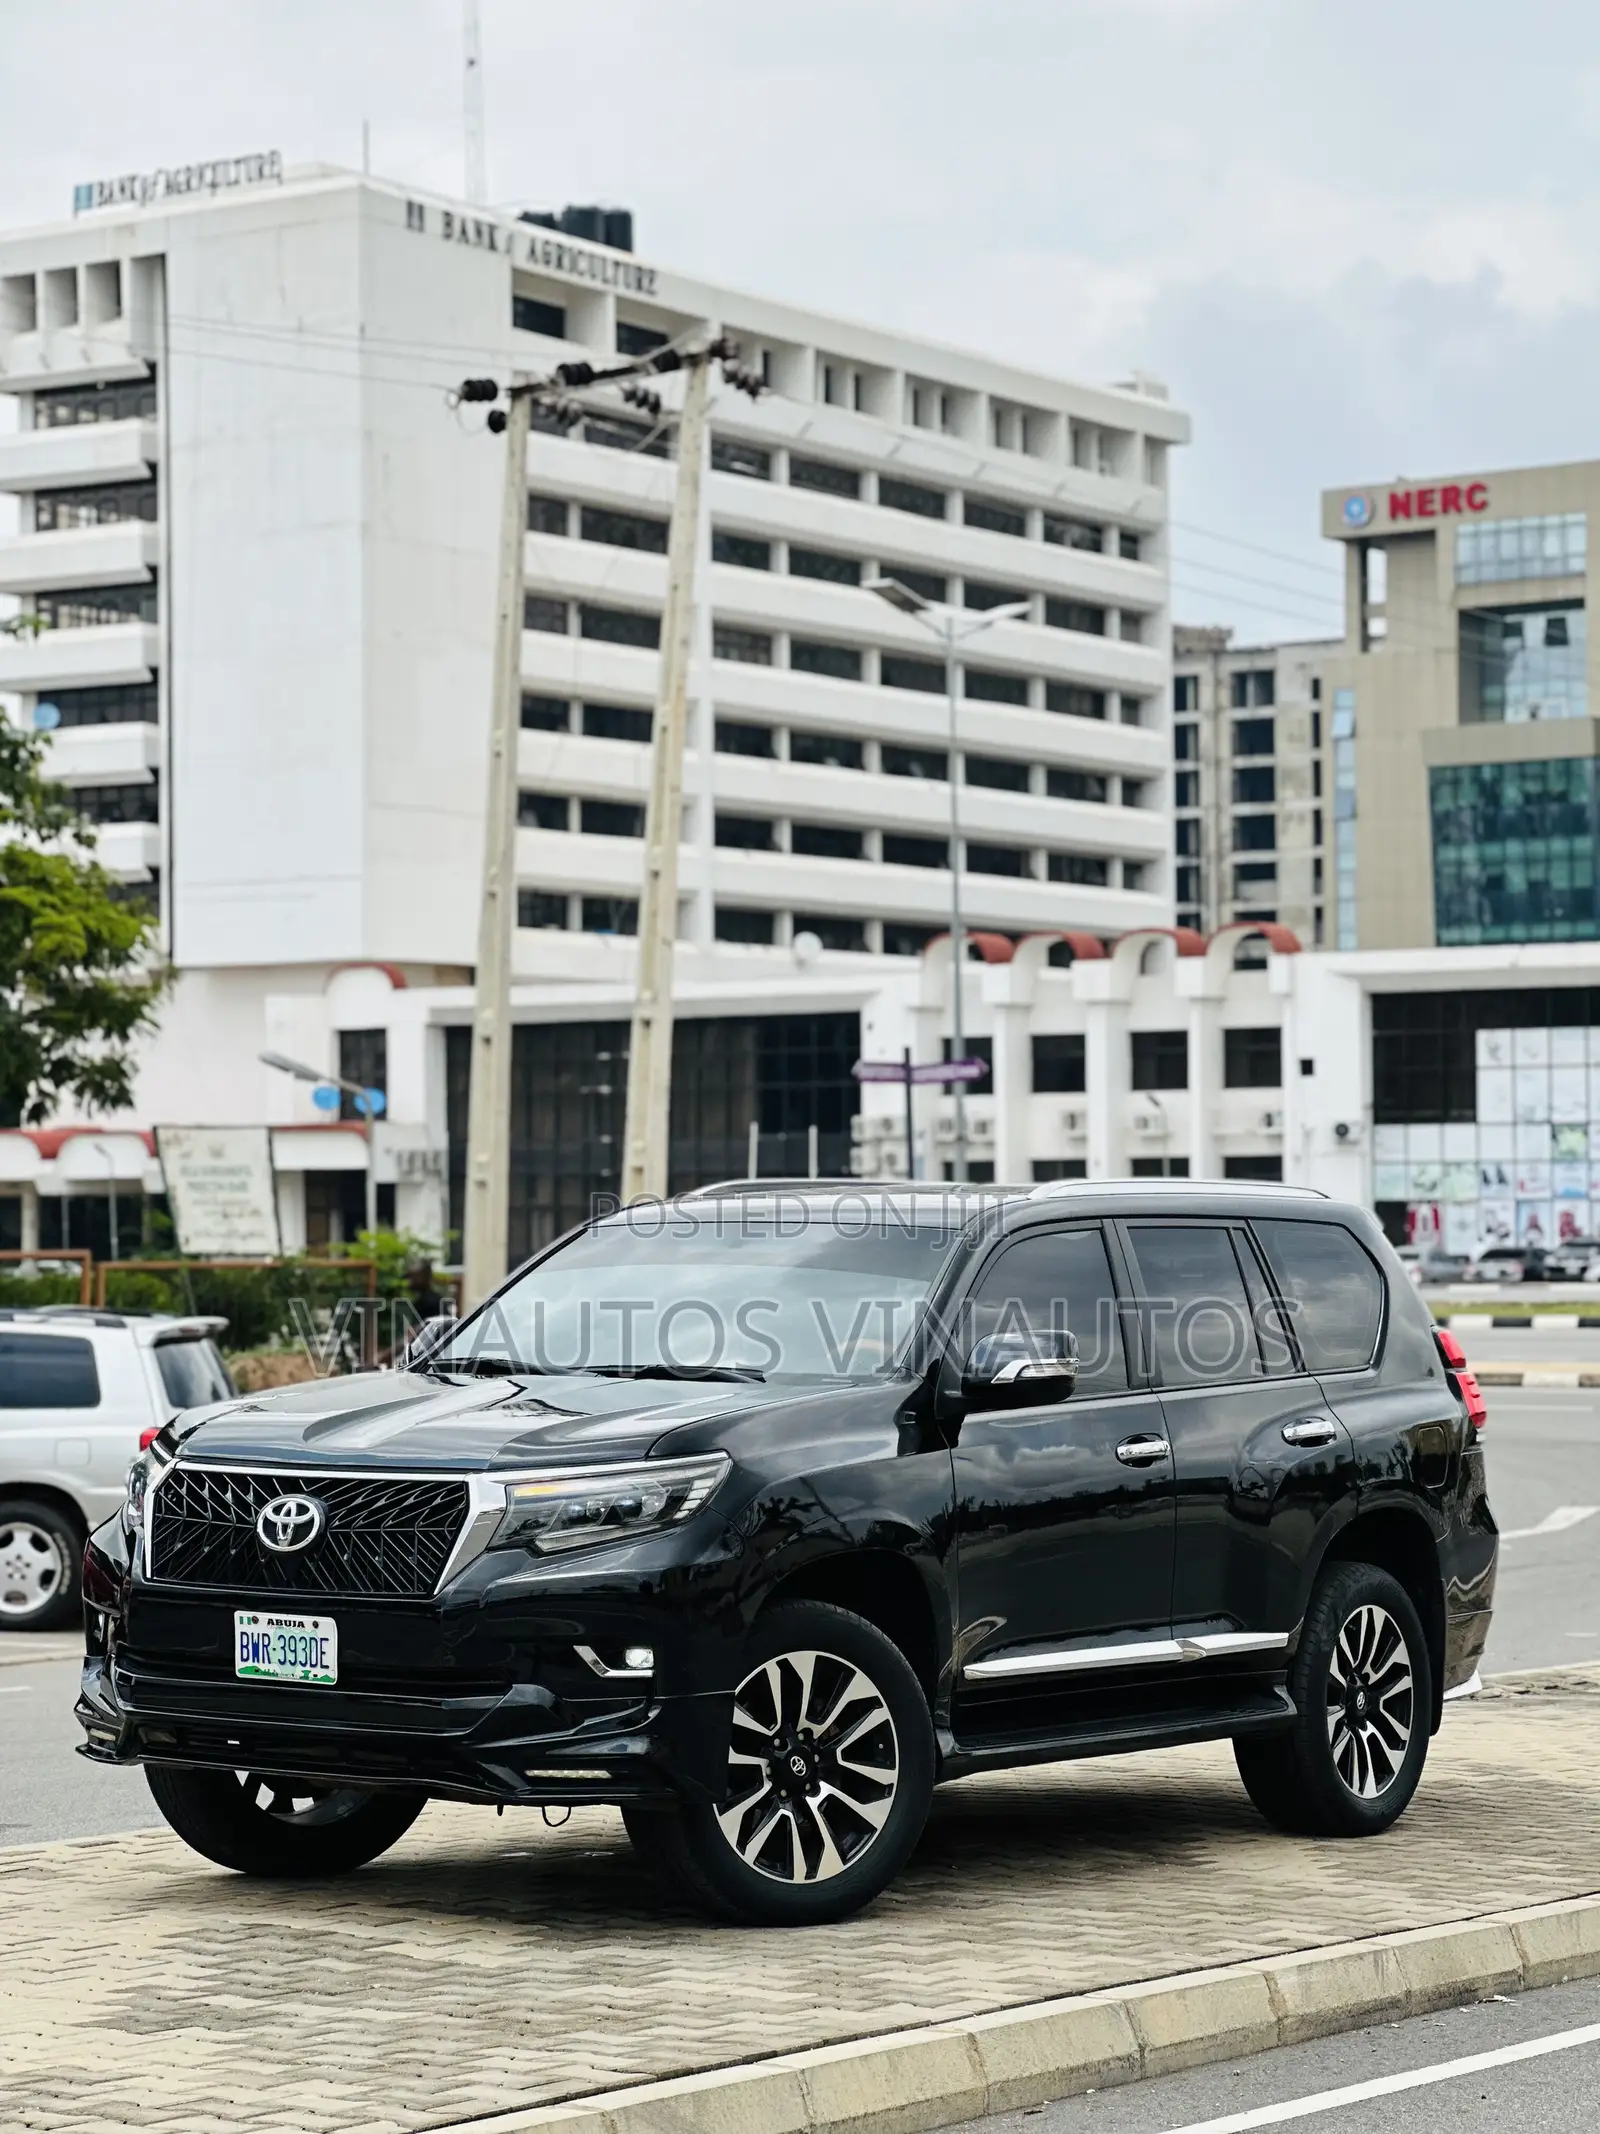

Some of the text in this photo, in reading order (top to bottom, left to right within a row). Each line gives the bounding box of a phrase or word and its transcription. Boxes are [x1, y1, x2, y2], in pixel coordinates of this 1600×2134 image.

[442, 209, 498, 252] BANK
[525, 236, 659, 296] AGRICULTURE
[1388, 482, 1488, 521] NERC
[266, 1618, 305, 1628] ABUJA
